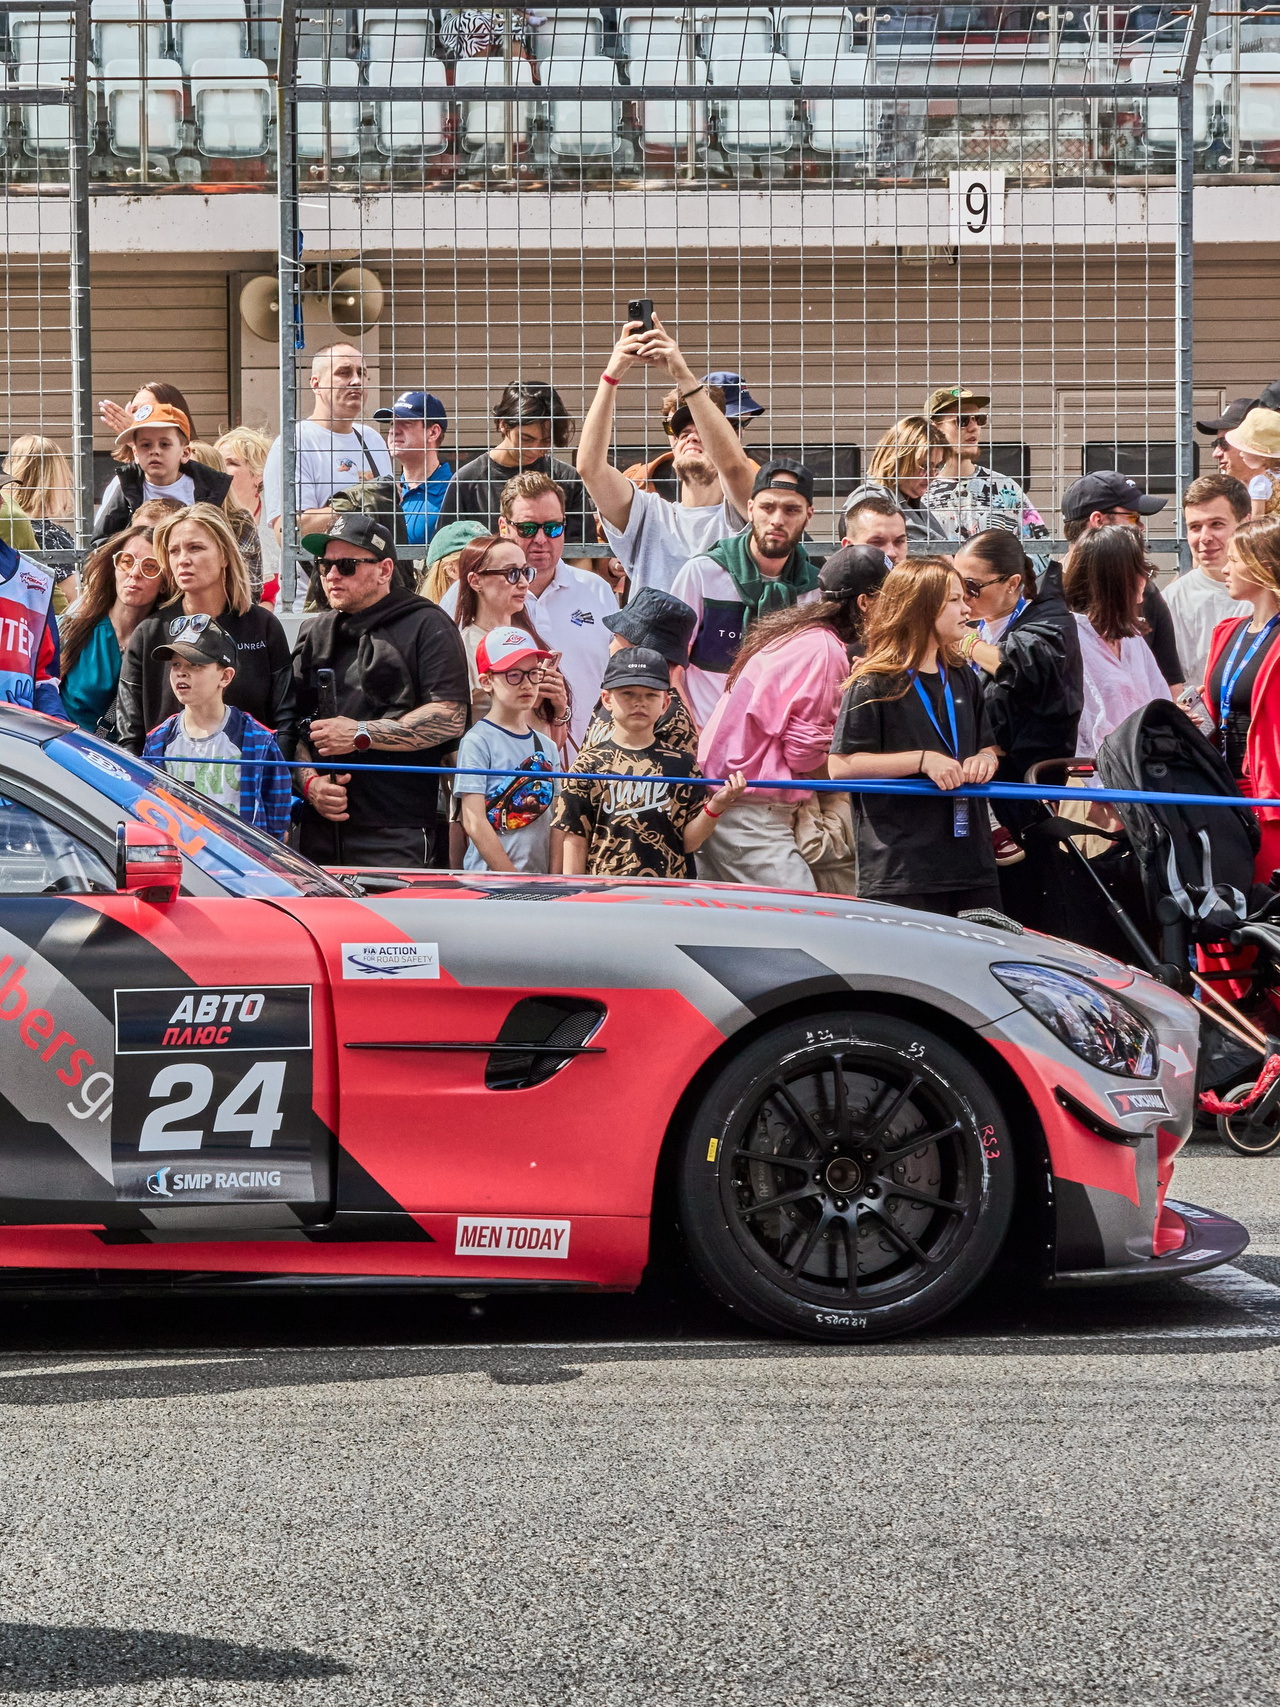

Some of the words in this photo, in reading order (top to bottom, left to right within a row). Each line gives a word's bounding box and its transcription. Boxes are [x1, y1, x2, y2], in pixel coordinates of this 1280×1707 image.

[966, 182, 988, 234] 9
[376, 955, 400, 963] ROAD
[401, 955, 433, 963] SAFETY
[379, 946, 417, 955] ACTION
[169, 994, 265, 1024] АВТО
[162, 1026, 232, 1046] ПЛЮС
[139, 1061, 287, 1152] 24
[173, 1173, 212, 1190] SMP
[215, 1171, 281, 1188] RACING
[460, 1225, 503, 1249] MEN
[506, 1227, 566, 1251] TODAY
